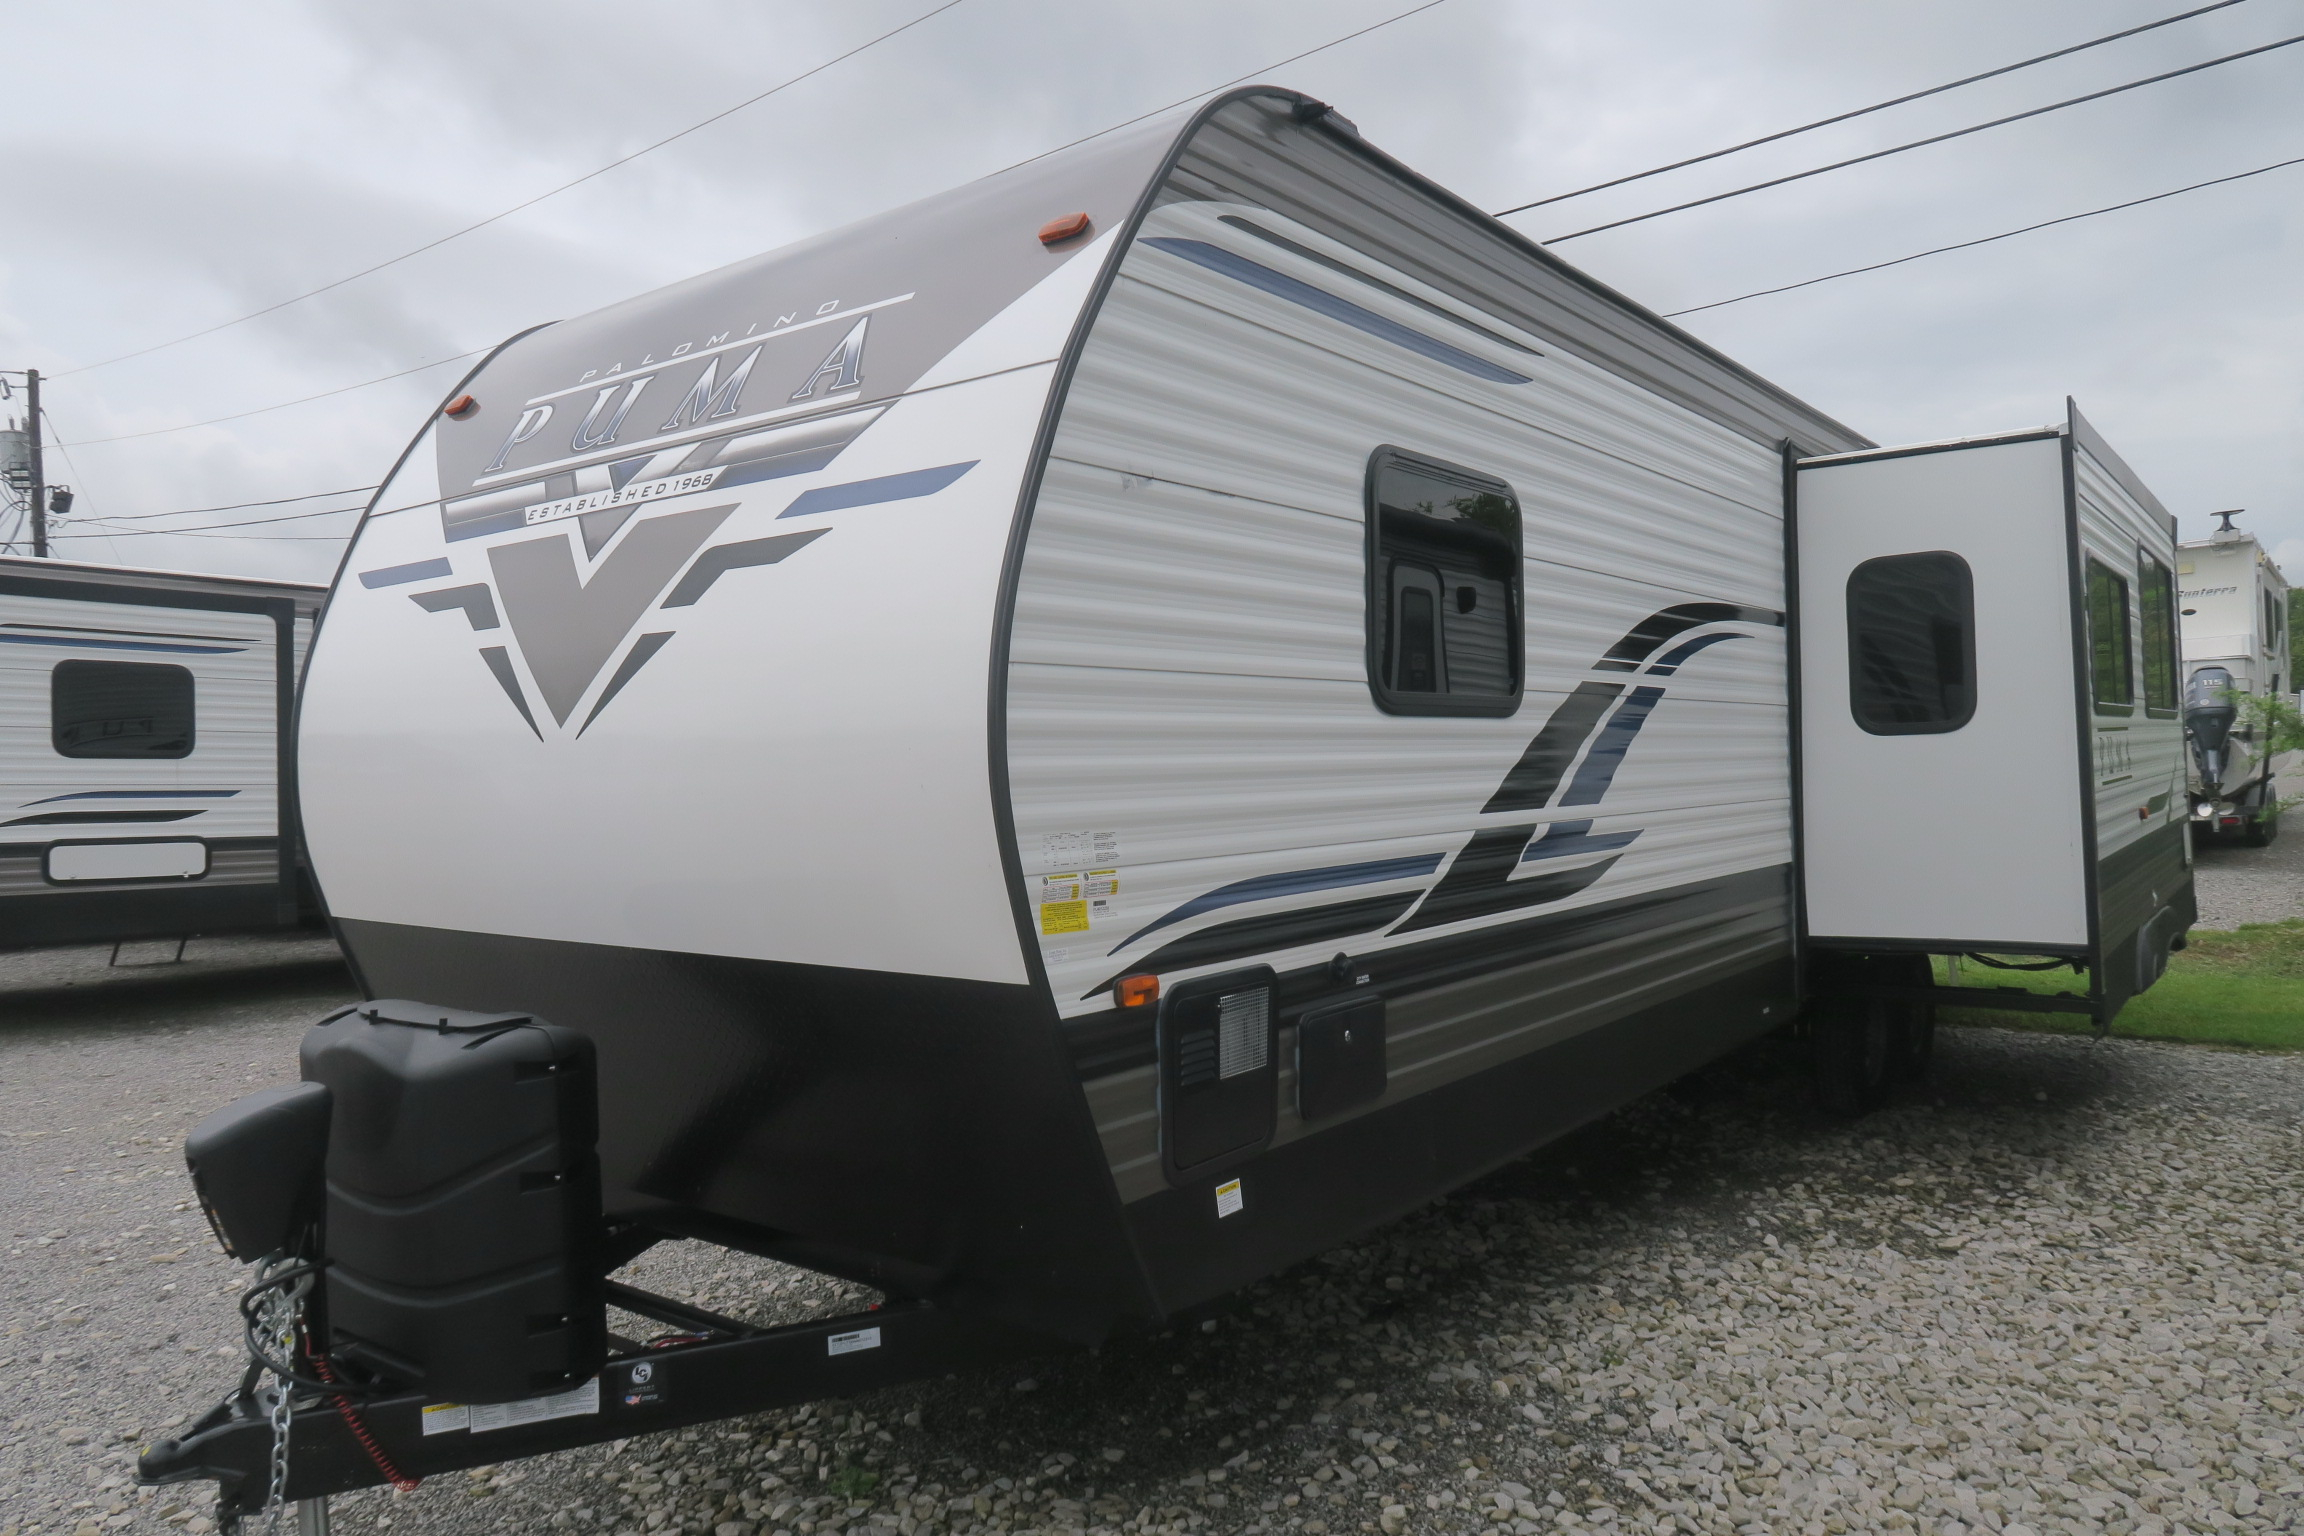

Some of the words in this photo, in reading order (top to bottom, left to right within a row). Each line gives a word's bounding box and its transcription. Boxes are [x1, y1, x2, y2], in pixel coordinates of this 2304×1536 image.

[579, 299, 840, 383] PALOMINO
[482, 314, 871, 474] PUMA
[527, 483, 668, 521] ESTABLISHED
[673, 473, 714, 491] 1968
